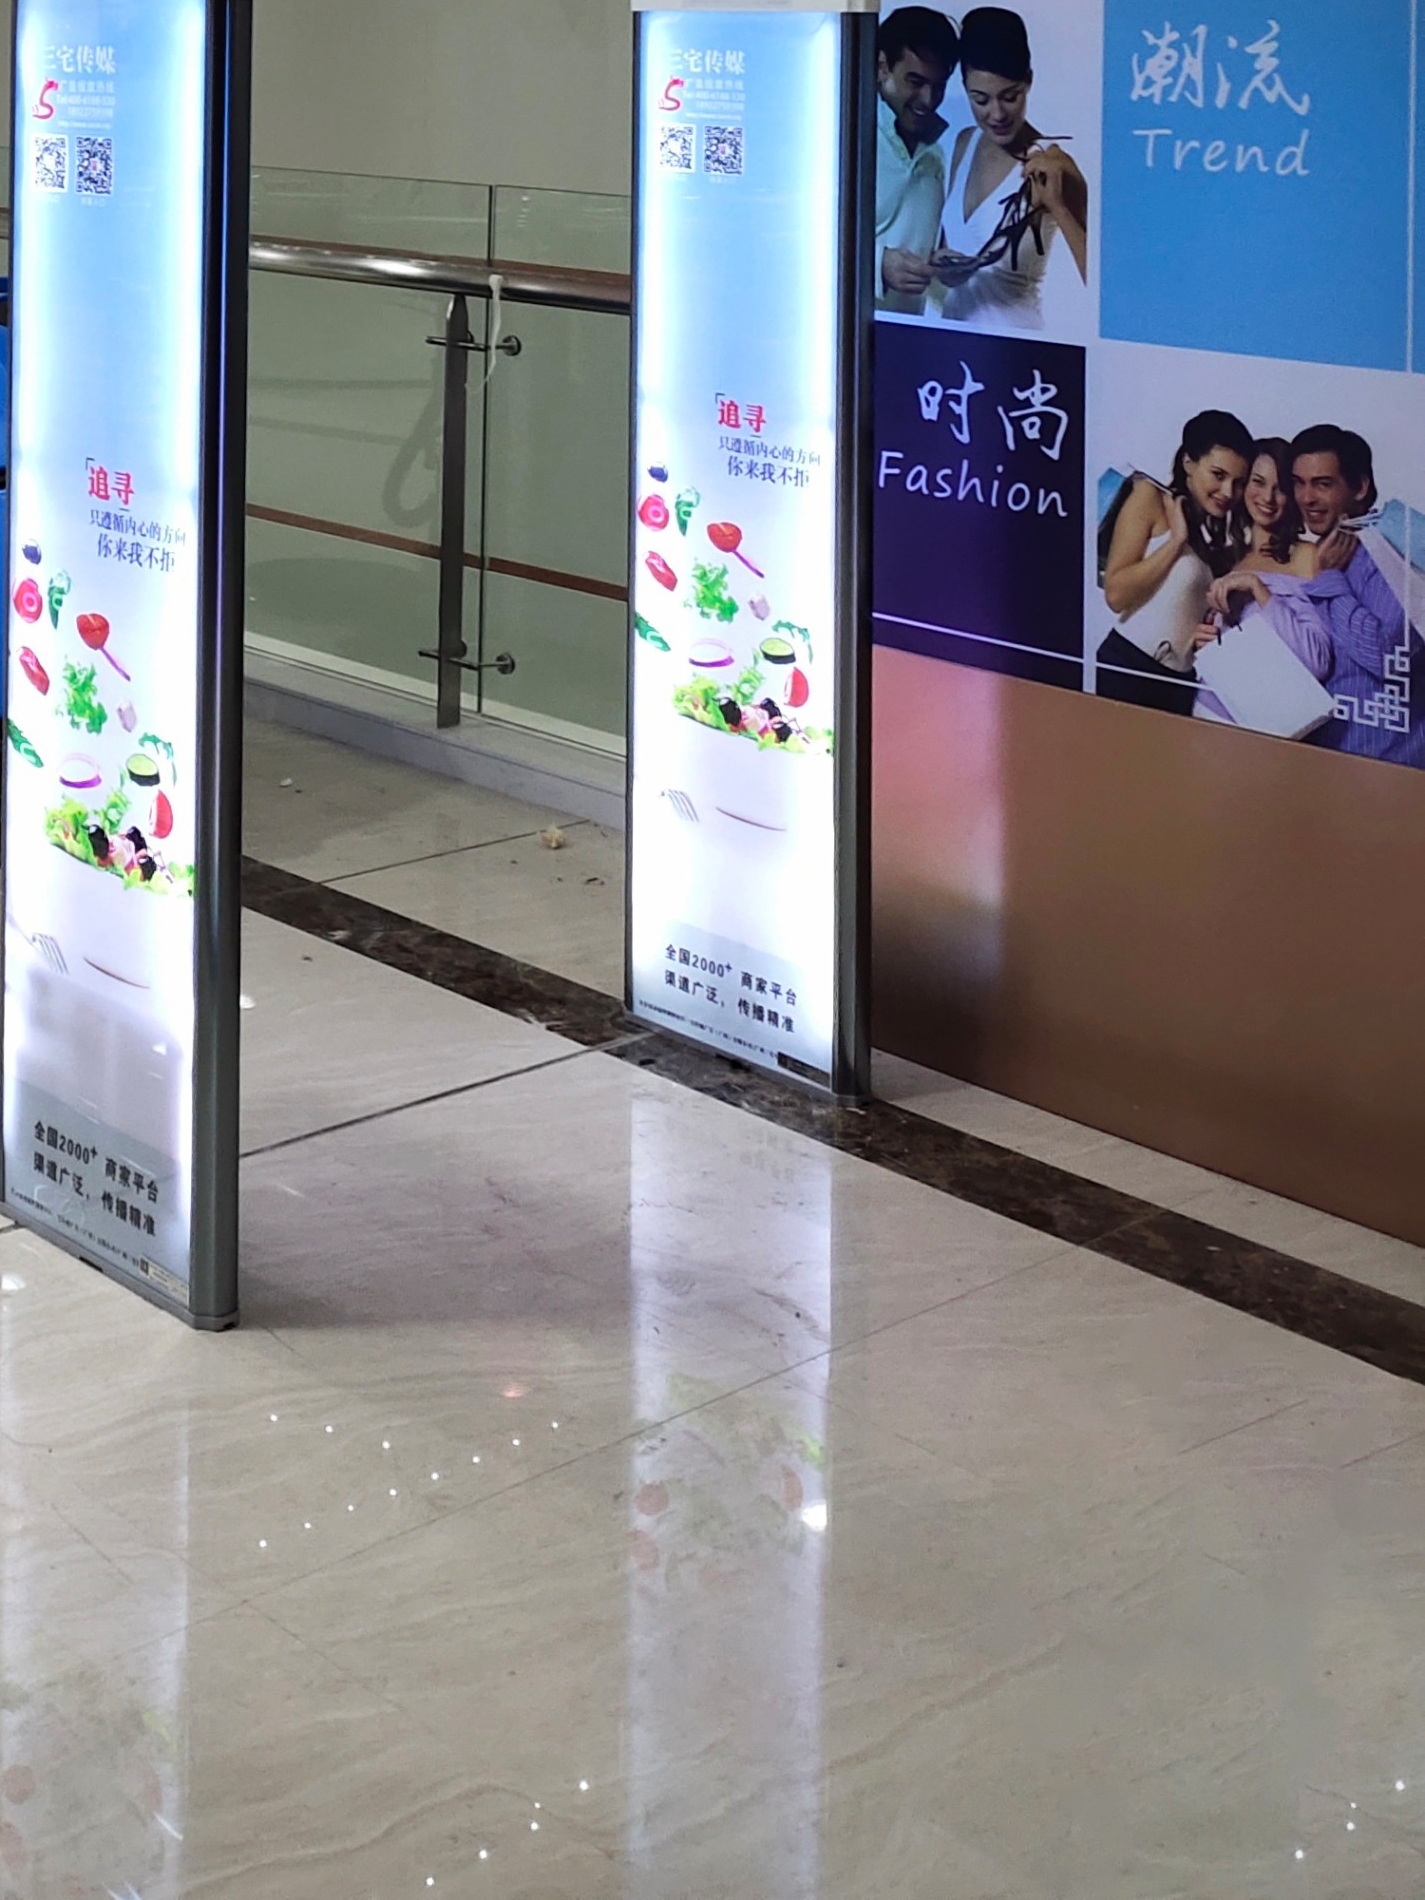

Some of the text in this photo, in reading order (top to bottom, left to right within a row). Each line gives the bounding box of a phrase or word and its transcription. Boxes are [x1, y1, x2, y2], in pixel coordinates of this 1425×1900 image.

[1130, 19, 1312, 116] 潮流
[1132, 126, 1310, 177] Trend
[718, 400, 767, 433] 追寻
[918, 360, 1070, 461] 时尚
[88, 466, 135, 506] 追寻
[878, 450, 1069, 518] Fashion
